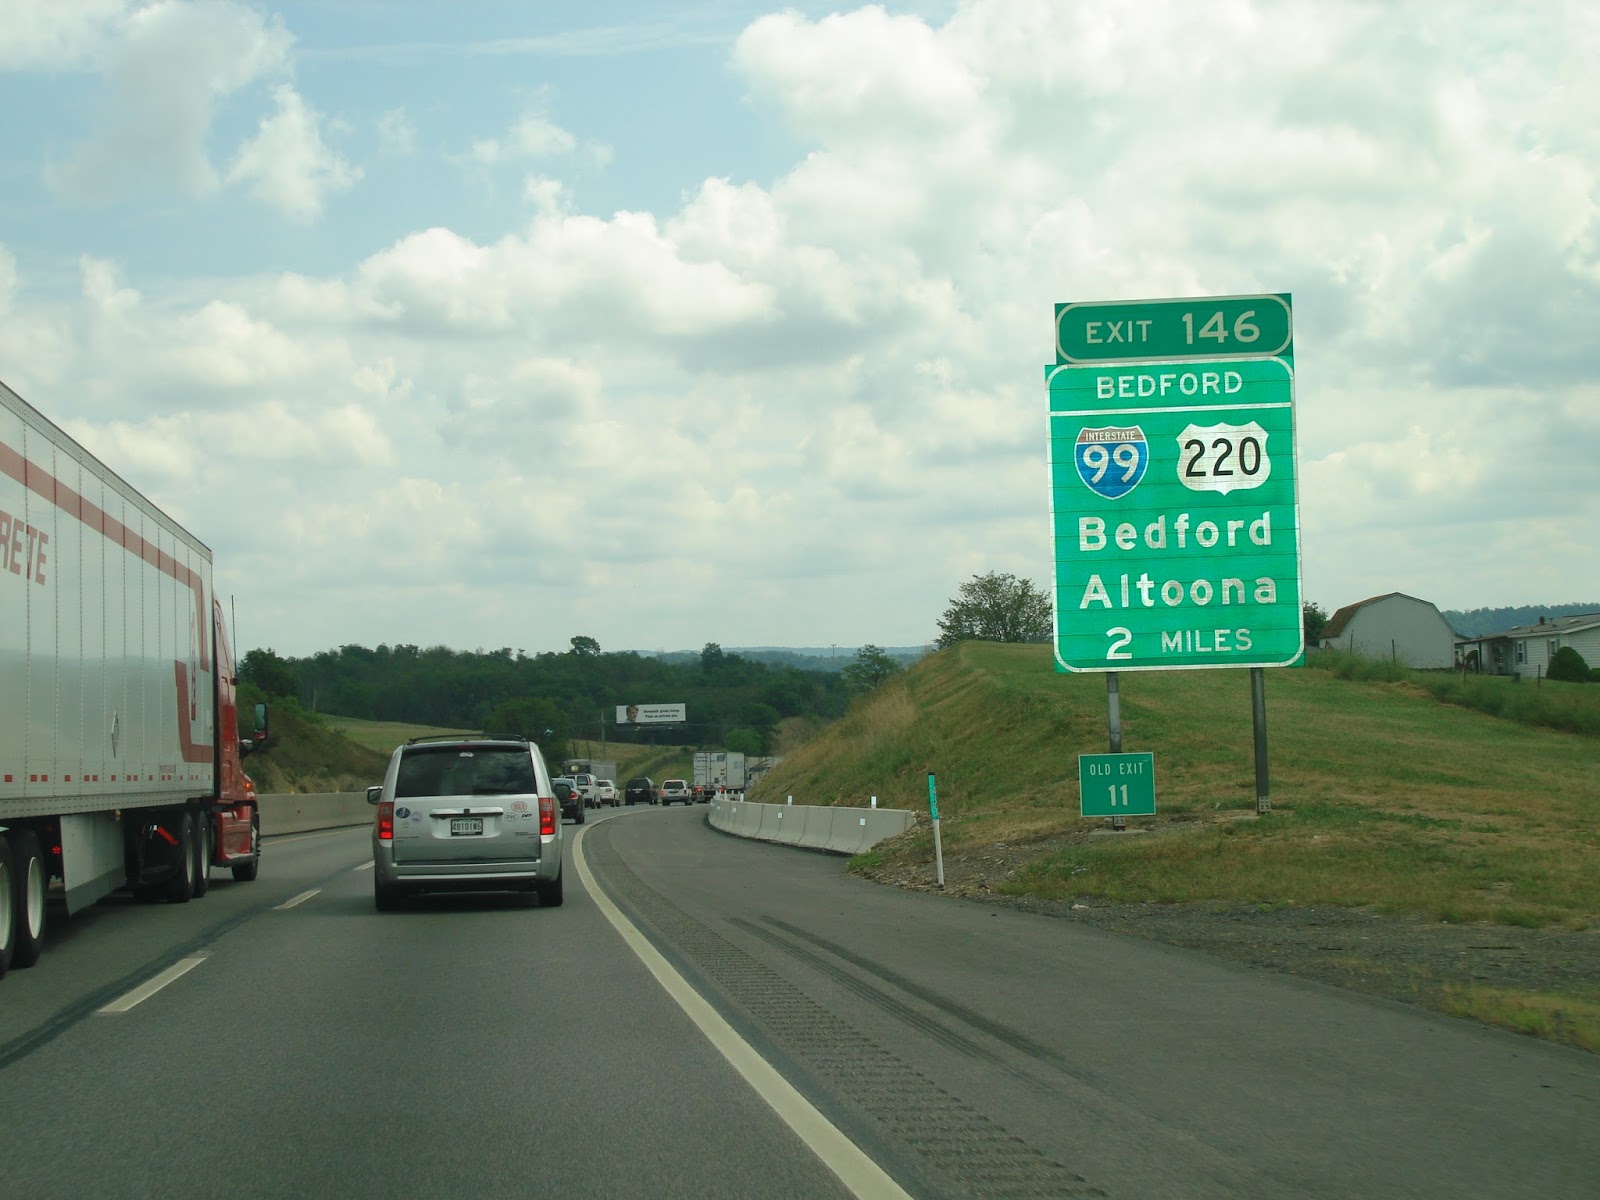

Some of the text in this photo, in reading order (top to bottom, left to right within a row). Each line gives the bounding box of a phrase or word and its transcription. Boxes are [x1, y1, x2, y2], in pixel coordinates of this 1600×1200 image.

[1086, 310, 1260, 345] EXIT 146
[1097, 371, 1243, 399] BEDFORD
[1085, 430, 1136, 441] INTERSTATE
[1082, 444, 1139, 484] 99
[1184, 436, 1261, 478] 220
[1078, 511, 1272, 552] Bedford
[1079, 572, 1276, 609] Altoona
[1106, 627, 1252, 660] 2 MILES
[1089, 762, 1144, 776] OLD EXIT
[1108, 784, 1128, 806] 11
